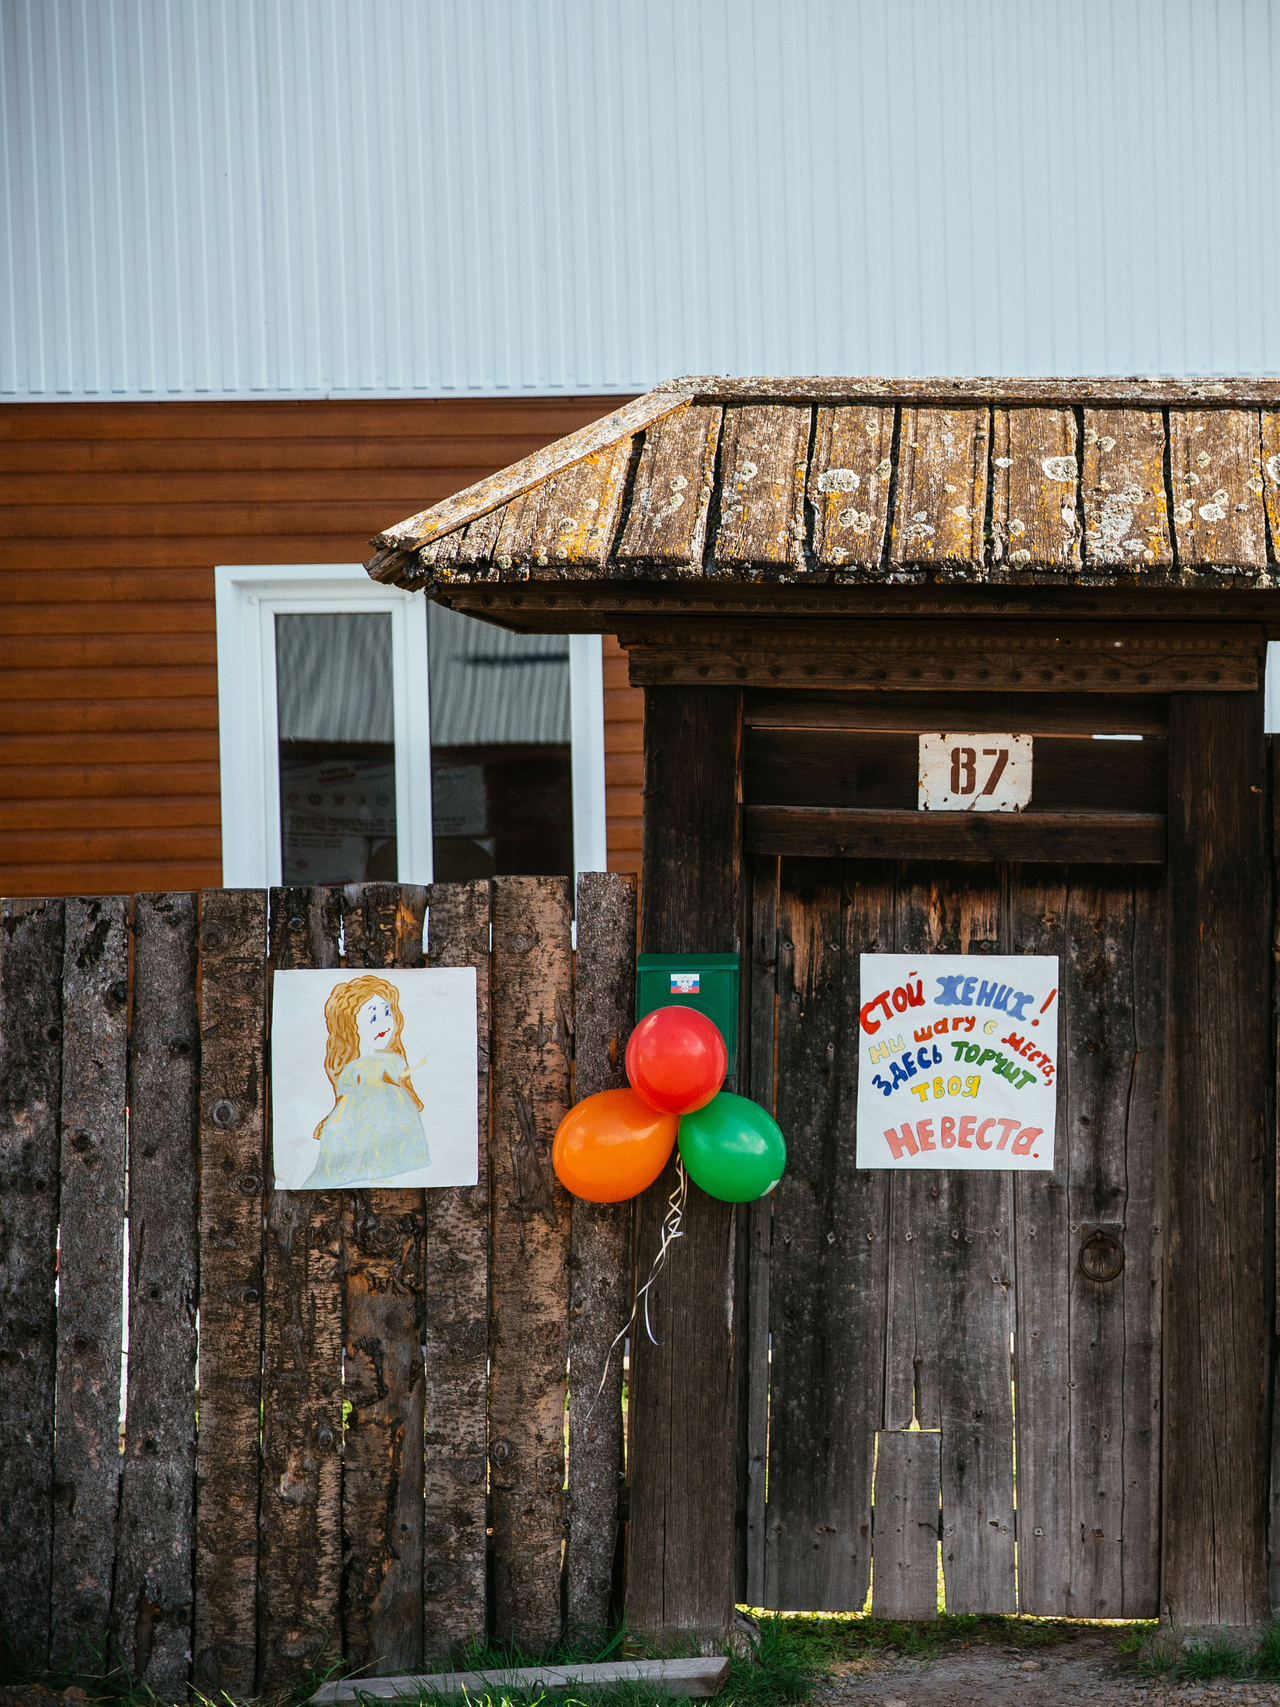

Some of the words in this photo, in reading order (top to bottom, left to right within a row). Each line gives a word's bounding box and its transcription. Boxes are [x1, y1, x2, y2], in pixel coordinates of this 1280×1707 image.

[951, 747, 1009, 795] 87
[860, 971, 926, 1035] СТОЙ
[933, 974, 1058, 1027] ЖЕНИХ!
[871, 1044, 943, 1097] ЗДЕСЬ
[951, 1041, 1037, 1090] ТОРЧИТ
[911, 1075, 981, 1102] ТВОЯ
